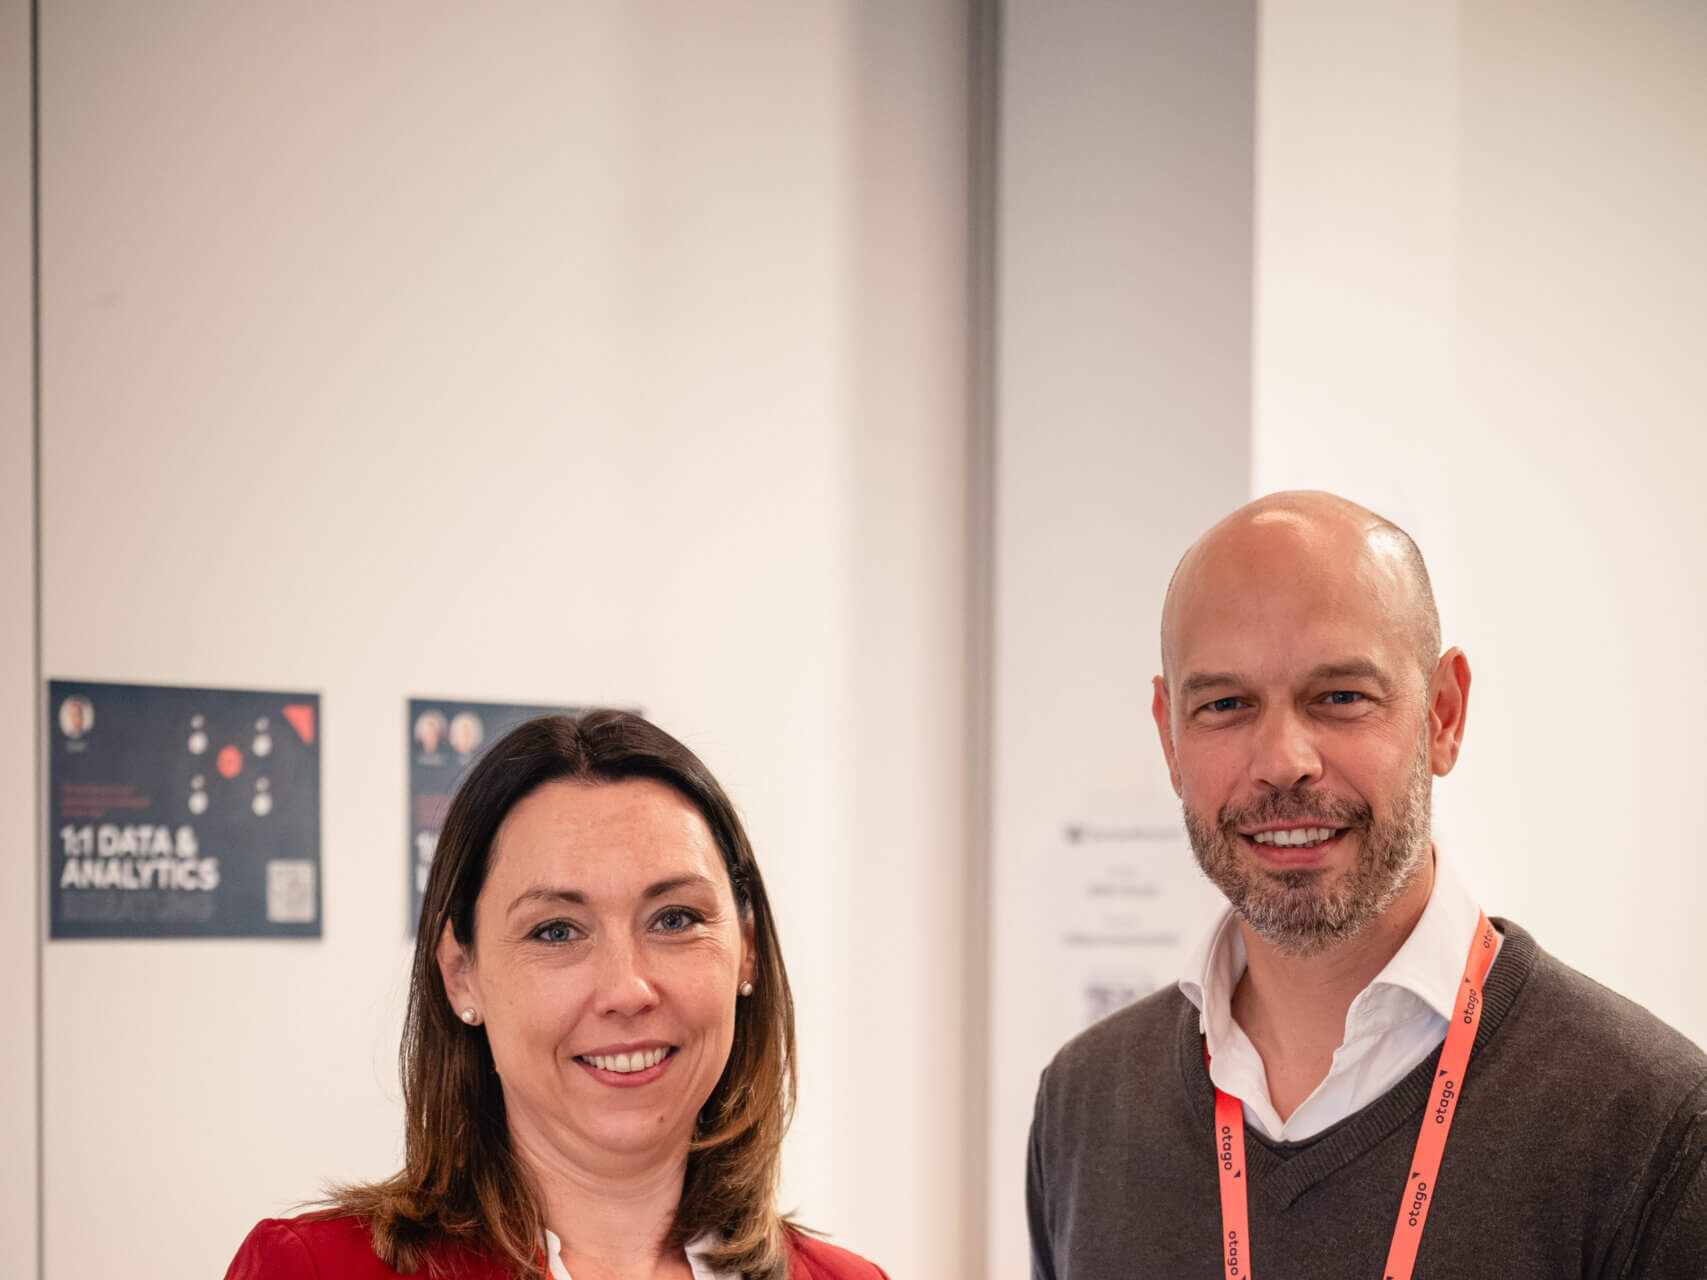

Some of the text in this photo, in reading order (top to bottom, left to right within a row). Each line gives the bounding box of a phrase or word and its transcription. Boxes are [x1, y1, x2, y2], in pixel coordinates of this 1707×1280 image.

[97, 824, 172, 857] DATA
[60, 857, 220, 890] ANALYTICS
[1464, 988, 1477, 1024] otago
[1435, 1080, 1455, 1124] otago
[1220, 1126, 1233, 1171] otago
[1408, 1182, 1427, 1227] otago
[1228, 1230, 1239, 1276] otago
